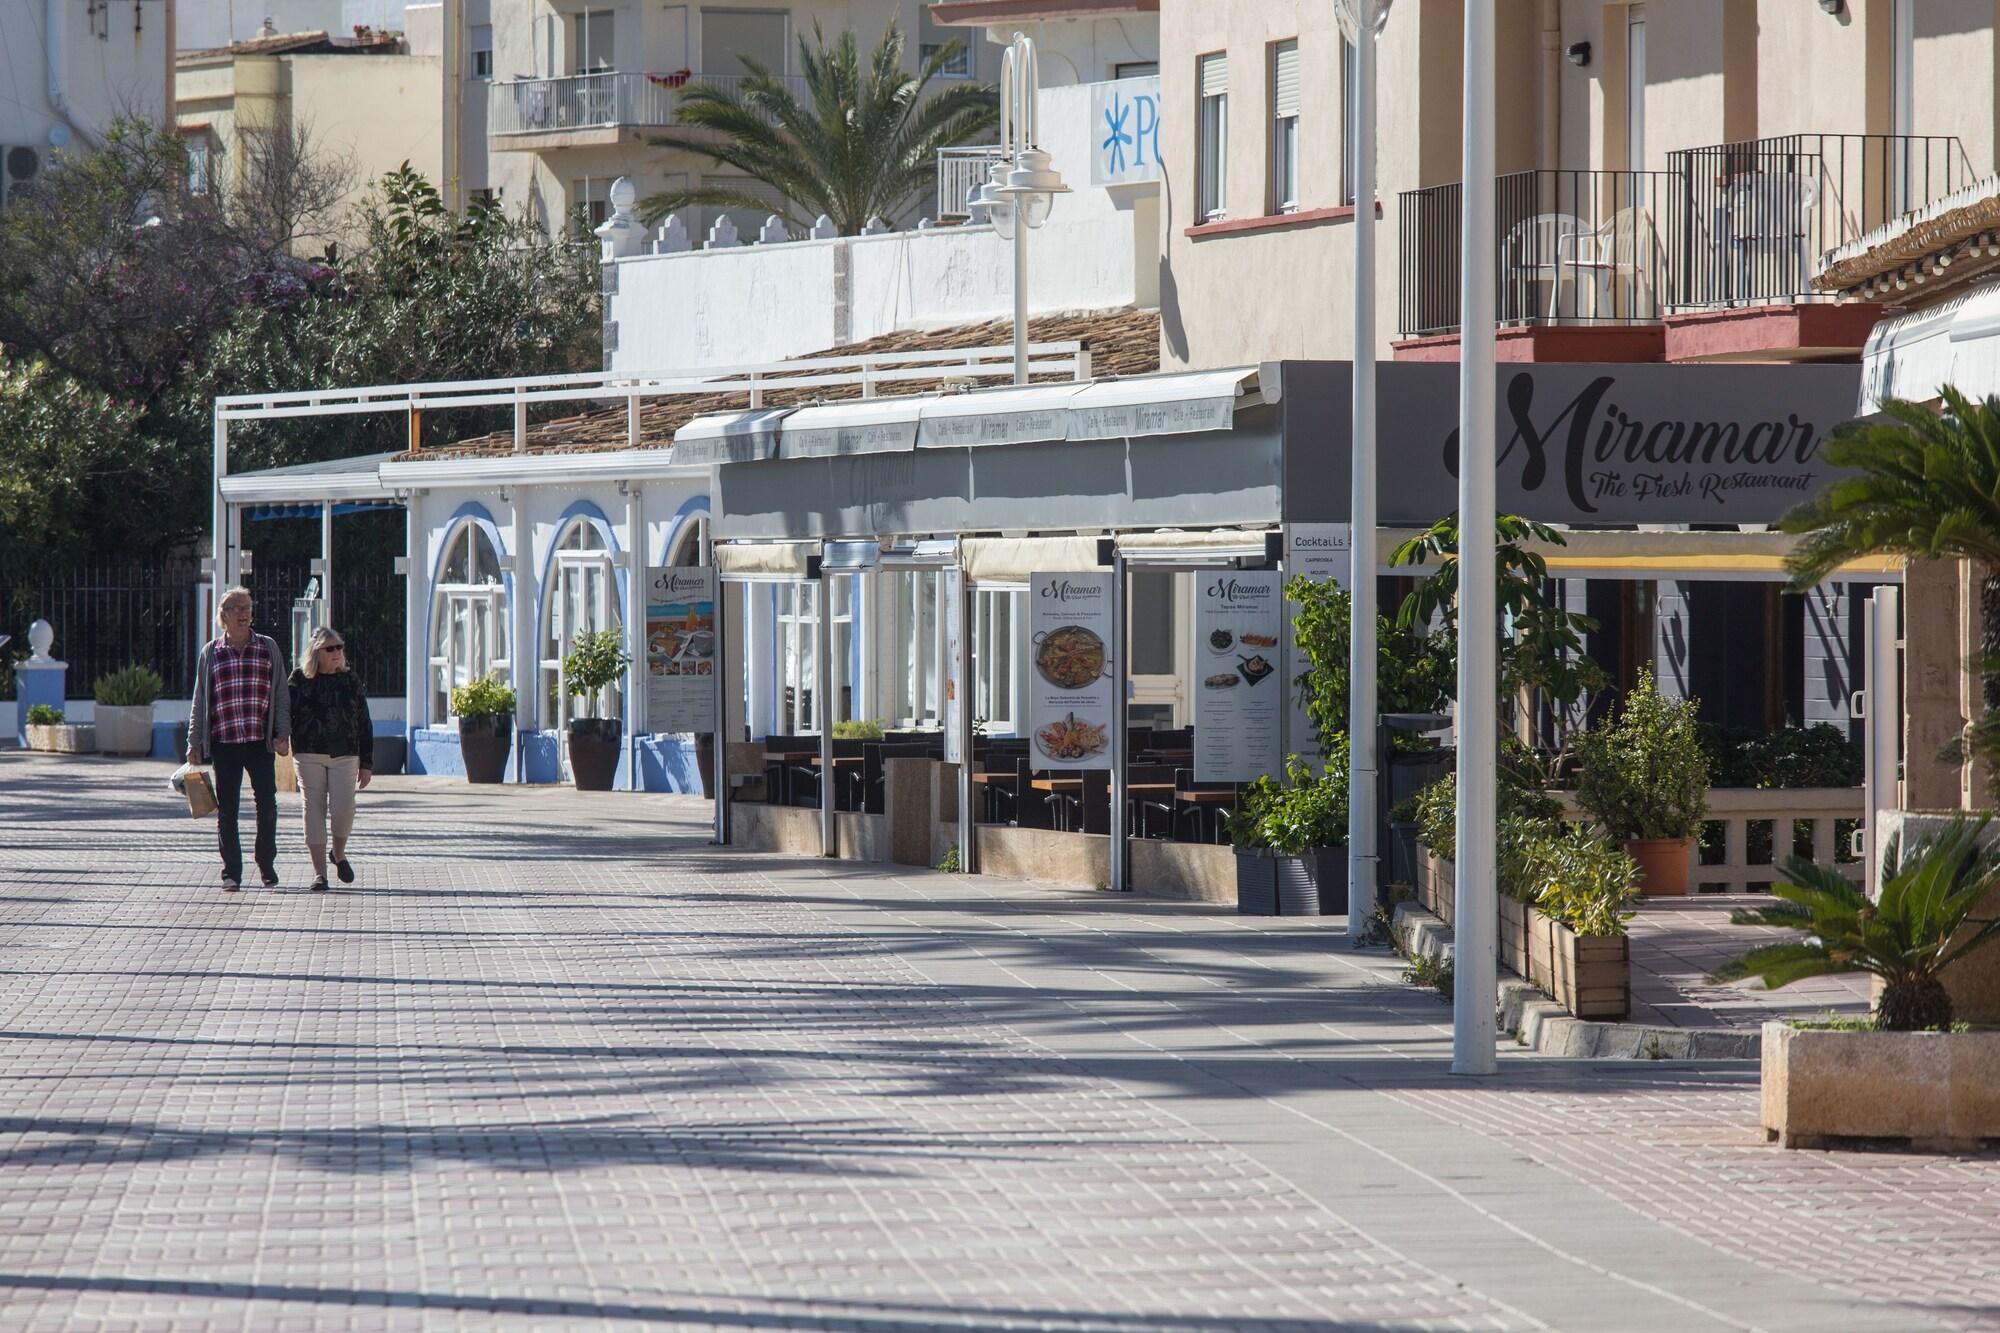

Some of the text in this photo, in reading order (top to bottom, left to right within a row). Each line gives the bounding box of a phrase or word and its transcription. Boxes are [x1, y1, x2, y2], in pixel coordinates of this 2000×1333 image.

[980, 417, 1009, 440] Miramar
[1135, 407, 1166, 431] Miramar
[1443, 372, 1822, 513] Miramar
[1589, 470, 1817, 504] The Fresh Restaurant
[654, 573, 705, 593] Miramar
[1041, 580, 1102, 603] Miramar
[1207, 578, 1271, 602] Miramar
